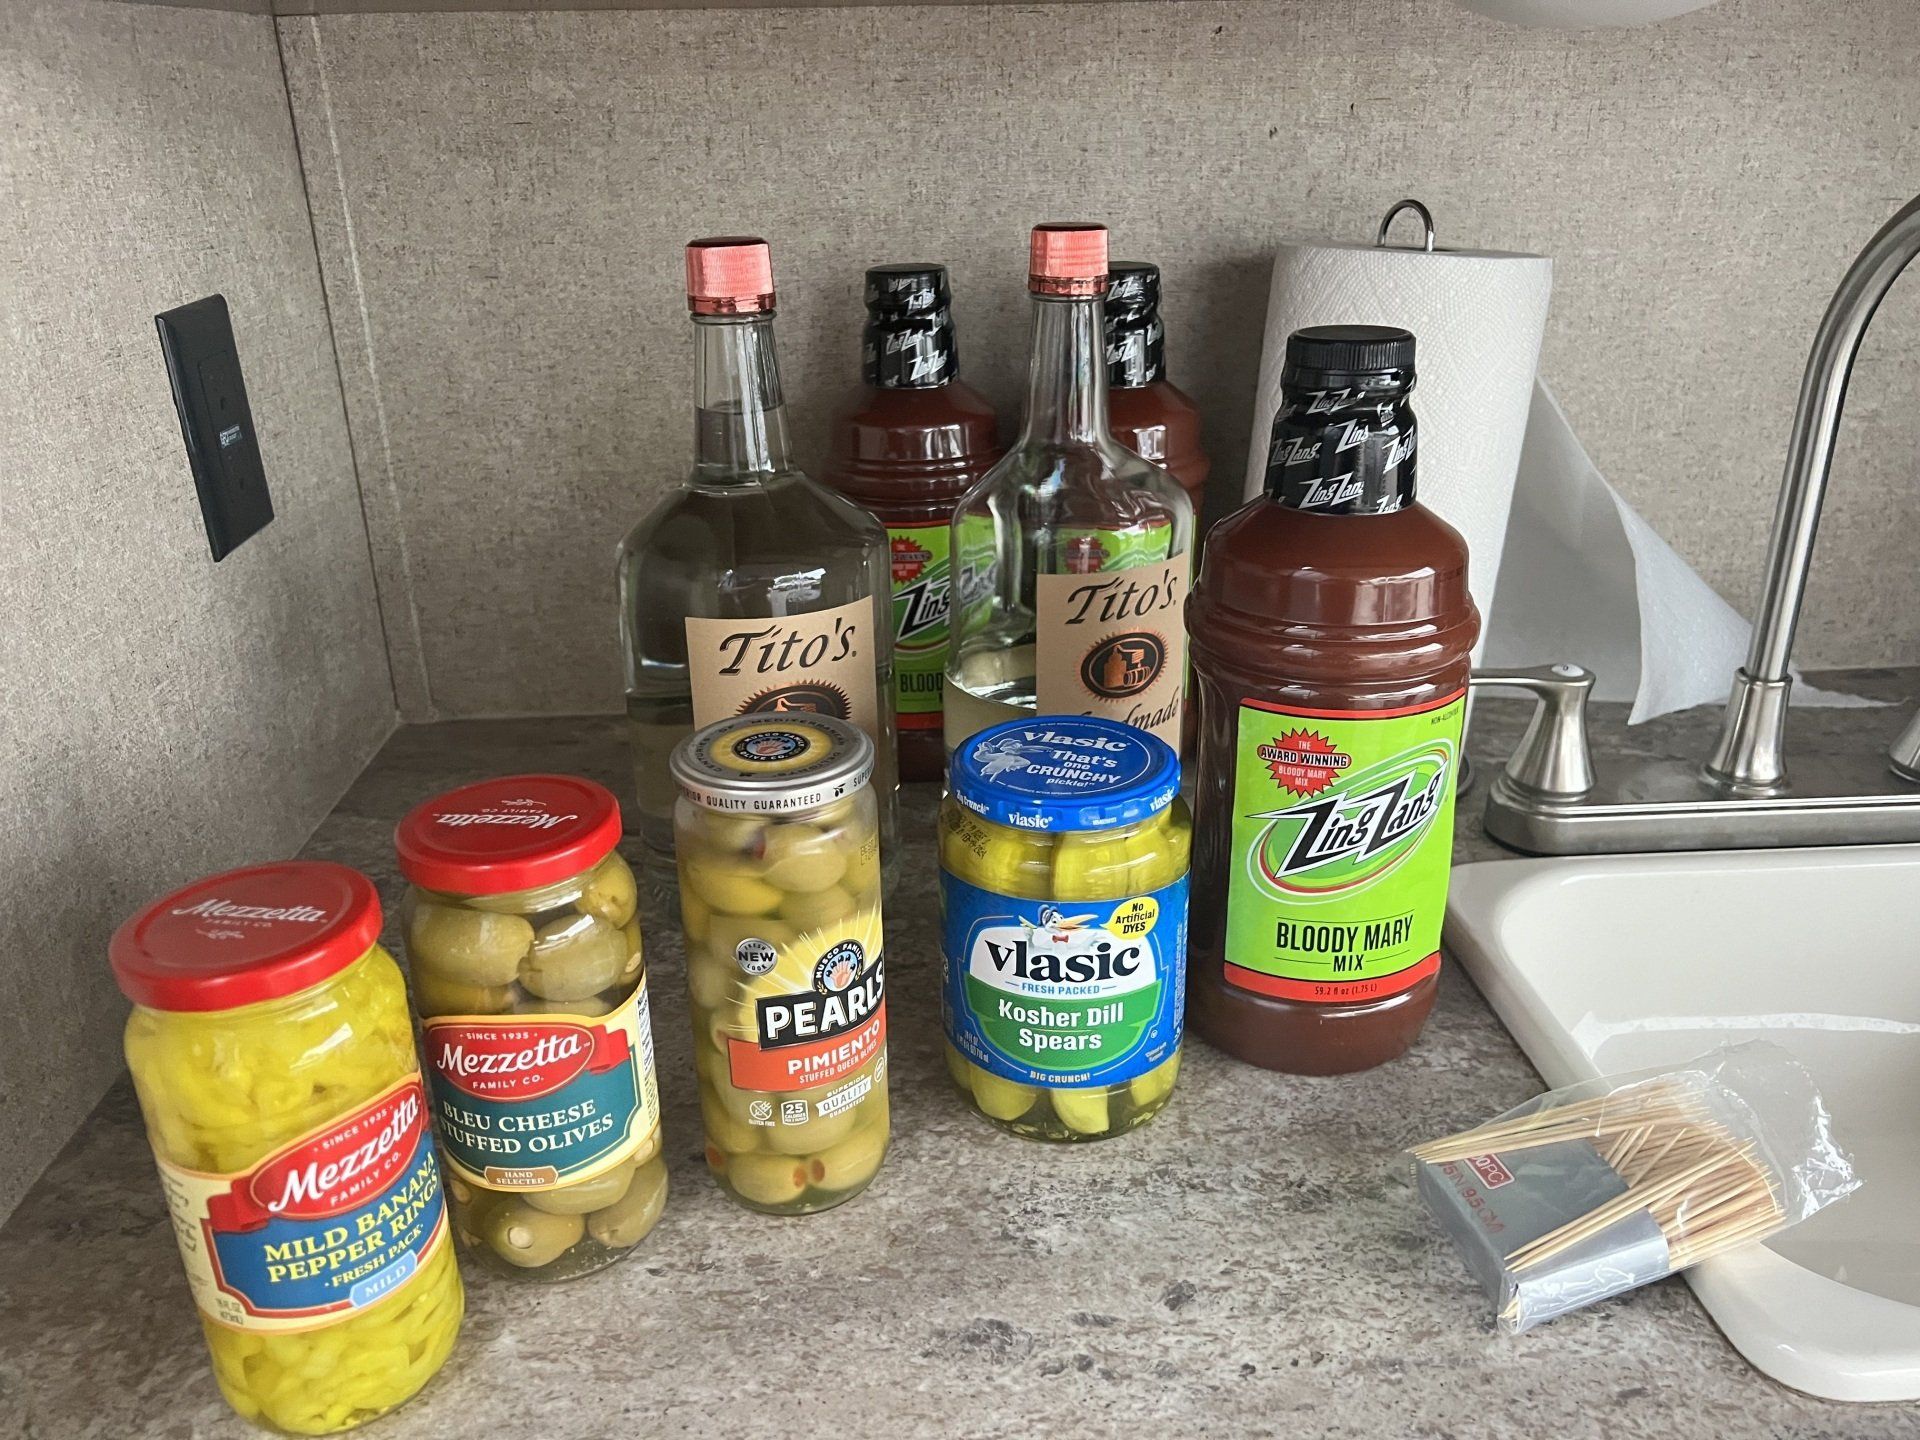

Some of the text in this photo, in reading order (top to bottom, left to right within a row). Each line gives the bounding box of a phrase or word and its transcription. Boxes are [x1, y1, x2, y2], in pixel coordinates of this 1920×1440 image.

[900, 672, 944, 693] BLOOD
[1298, 740, 1312, 750] THE
[1064, 761, 1091, 770] one
[1261, 747, 1347, 767] AWARD WINNING
[1026, 764, 1121, 784] CRUNCHY
[1278, 766, 1327, 779] BLOODY MARY
[1295, 777, 1309, 787] MIX
[706, 795, 747, 810] QUALITY
[754, 793, 822, 810] GUARANTEED
[436, 813, 578, 829] Mezzetta
[172, 899, 327, 923] Mezzetta
[1115, 909, 1155, 925] Artificial
[1131, 902, 1144, 913] No
[1122, 922, 1146, 934] DYES
[1276, 915, 1414, 953] BLOODY MARY
[738, 952, 774, 963] NEW
[747, 963, 767, 972] LOOK
[815, 943, 863, 979] MUSCO FAMILY
[1333, 954, 1364, 972] MIX
[1021, 982, 1100, 995] FRESH PACKED
[1315, 986, 1331, 996] 59.2
[764, 959, 884, 1041] PEARLS
[999, 998, 1124, 1027] Kosher Dill
[467, 1031, 530, 1041] SINCE 1935
[1018, 1028, 1102, 1054] Spears
[436, 1032, 582, 1077] Mezzetta
[787, 1018, 880, 1075] PIMIENTO
[799, 1067, 835, 1084] STUFFED
[836, 1055, 859, 1072] QUEEN
[860, 1039, 878, 1060] OLIVES
[472, 1074, 545, 1090] FAMILY CO.
[826, 1073, 866, 1097] SUPERIOR
[1029, 1070, 1091, 1083] BIG CRUNCH!
[822, 1080, 870, 1112] QUALITY
[443, 1099, 597, 1133] BLEU CHEESE
[785, 1102, 804, 1114] 25
[322, 1108, 388, 1150] SINCE 1935
[528, 1112, 614, 1154] OLIVES
[267, 1092, 419, 1213] Mezzetta
[329, 1151, 402, 1207] FAMILY CO.
[496, 1177, 545, 1186] SELECTED
[263, 1151, 435, 1263] MILD BANANA
[266, 1168, 439, 1283] PEPPER RINGS
[332, 1226, 422, 1288] FRESH PACK
[364, 1265, 407, 1298] MILD
